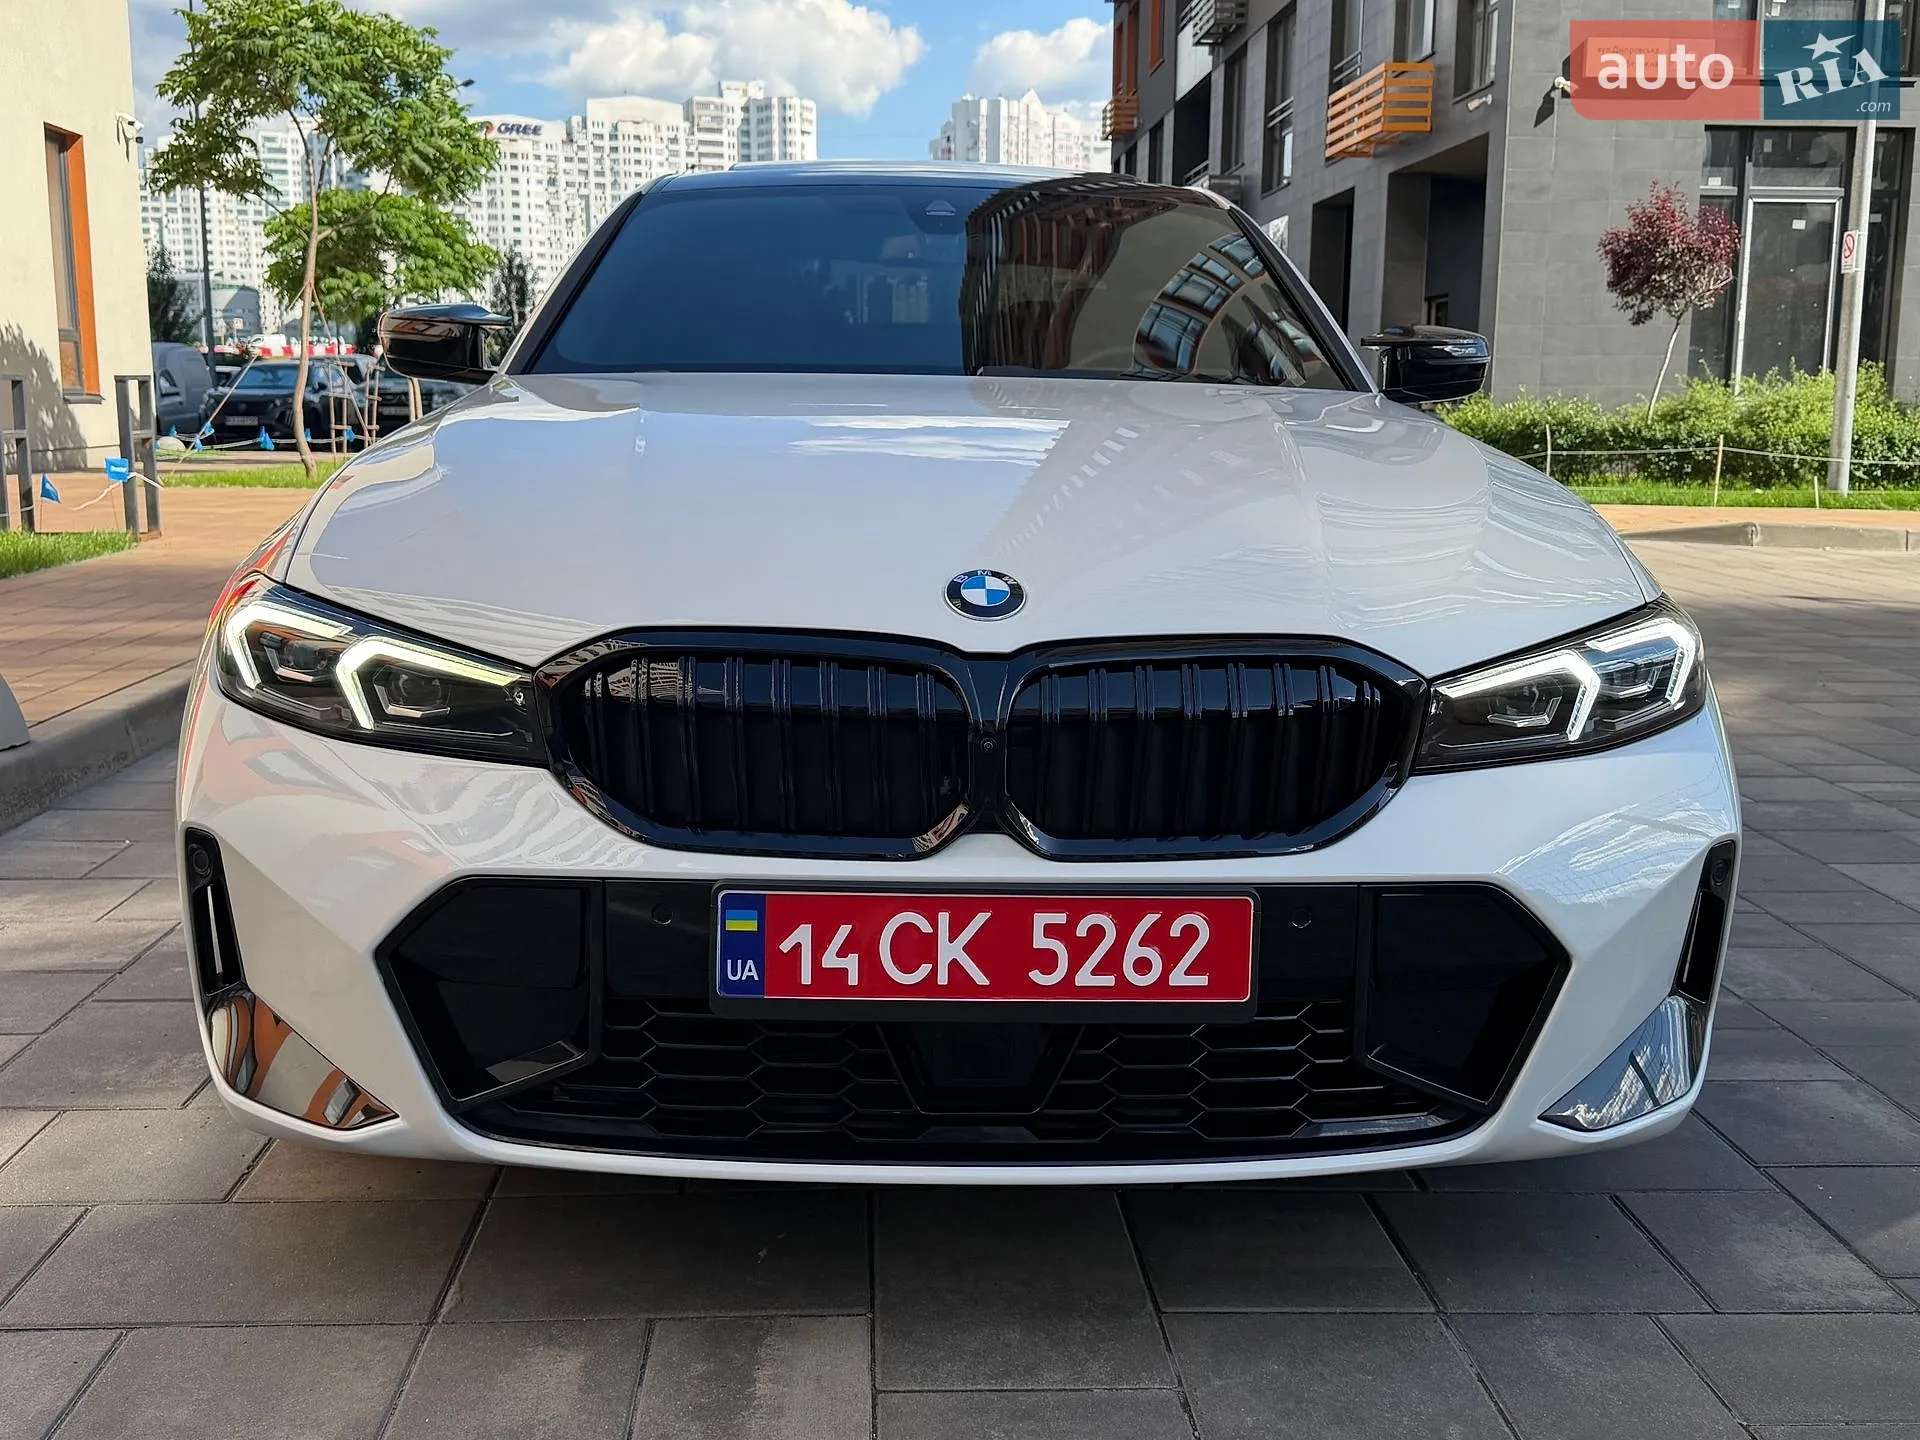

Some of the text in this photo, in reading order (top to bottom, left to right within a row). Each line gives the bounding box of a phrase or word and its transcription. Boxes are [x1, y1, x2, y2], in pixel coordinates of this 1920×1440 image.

[497, 122, 543, 136] GREE
[953, 570, 1018, 585] BMW
[778, 923, 860, 986] 14
[1028, 912, 1210, 987] 5262
[727, 959, 759, 981] UA
